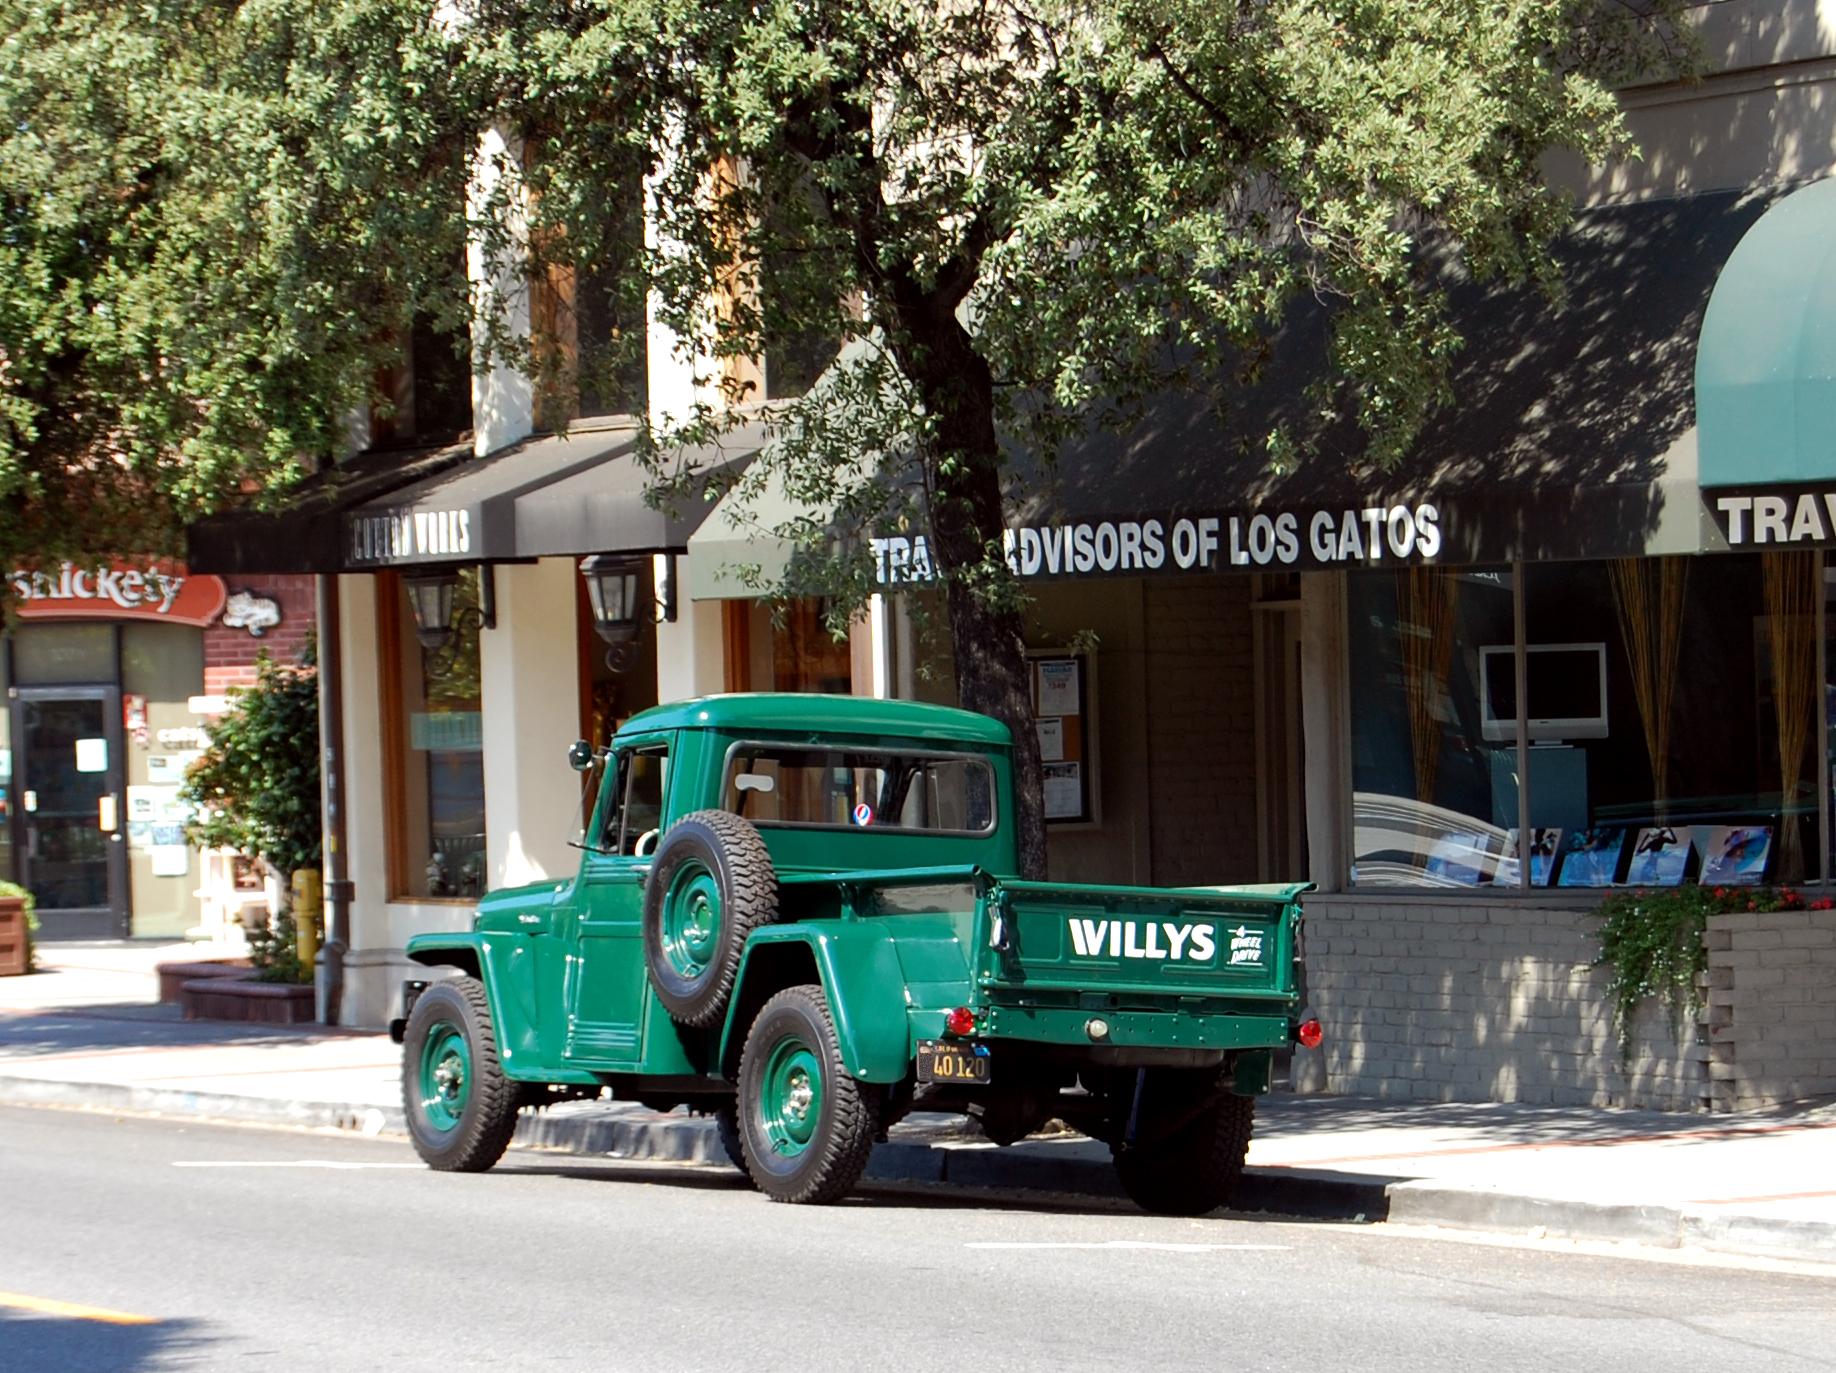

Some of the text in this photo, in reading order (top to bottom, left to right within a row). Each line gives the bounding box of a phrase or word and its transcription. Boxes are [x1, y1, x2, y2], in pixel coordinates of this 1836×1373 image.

[868, 503, 1441, 584] TRA ADVISORS OF LOS GATOS
[5, 559, 185, 613] snickety
[1068, 918, 1215, 960] WILLYS
[933, 1055, 953, 1076] 40
